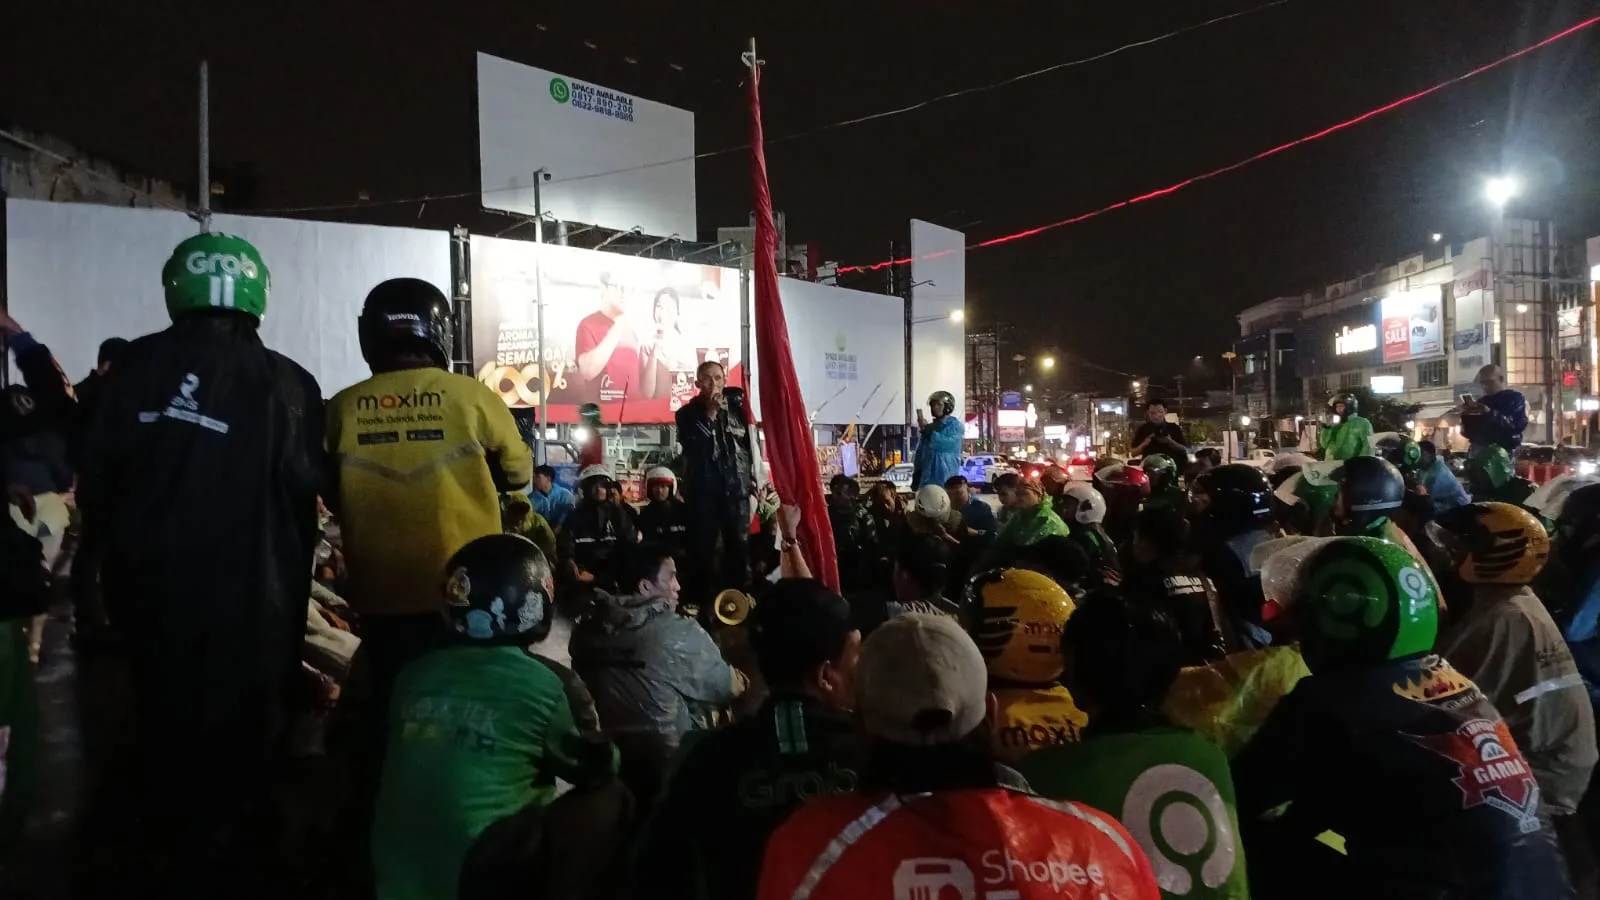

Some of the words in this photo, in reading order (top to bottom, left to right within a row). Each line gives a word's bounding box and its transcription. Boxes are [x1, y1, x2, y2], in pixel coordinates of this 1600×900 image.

[571, 82, 595, 95] SPACE
[596, 89, 633, 106] AVAILABLE
[185, 251, 259, 280] Grab
[387, 313, 421, 321] HONDA
[498, 330, 534, 342] AROMA
[1385, 327, 1408, 345] SALE
[356, 388, 442, 411] maxim
[1472, 758, 1527, 785] GARDA
[737, 759, 859, 809] Grab
[981, 847, 1106, 893] Shopee
